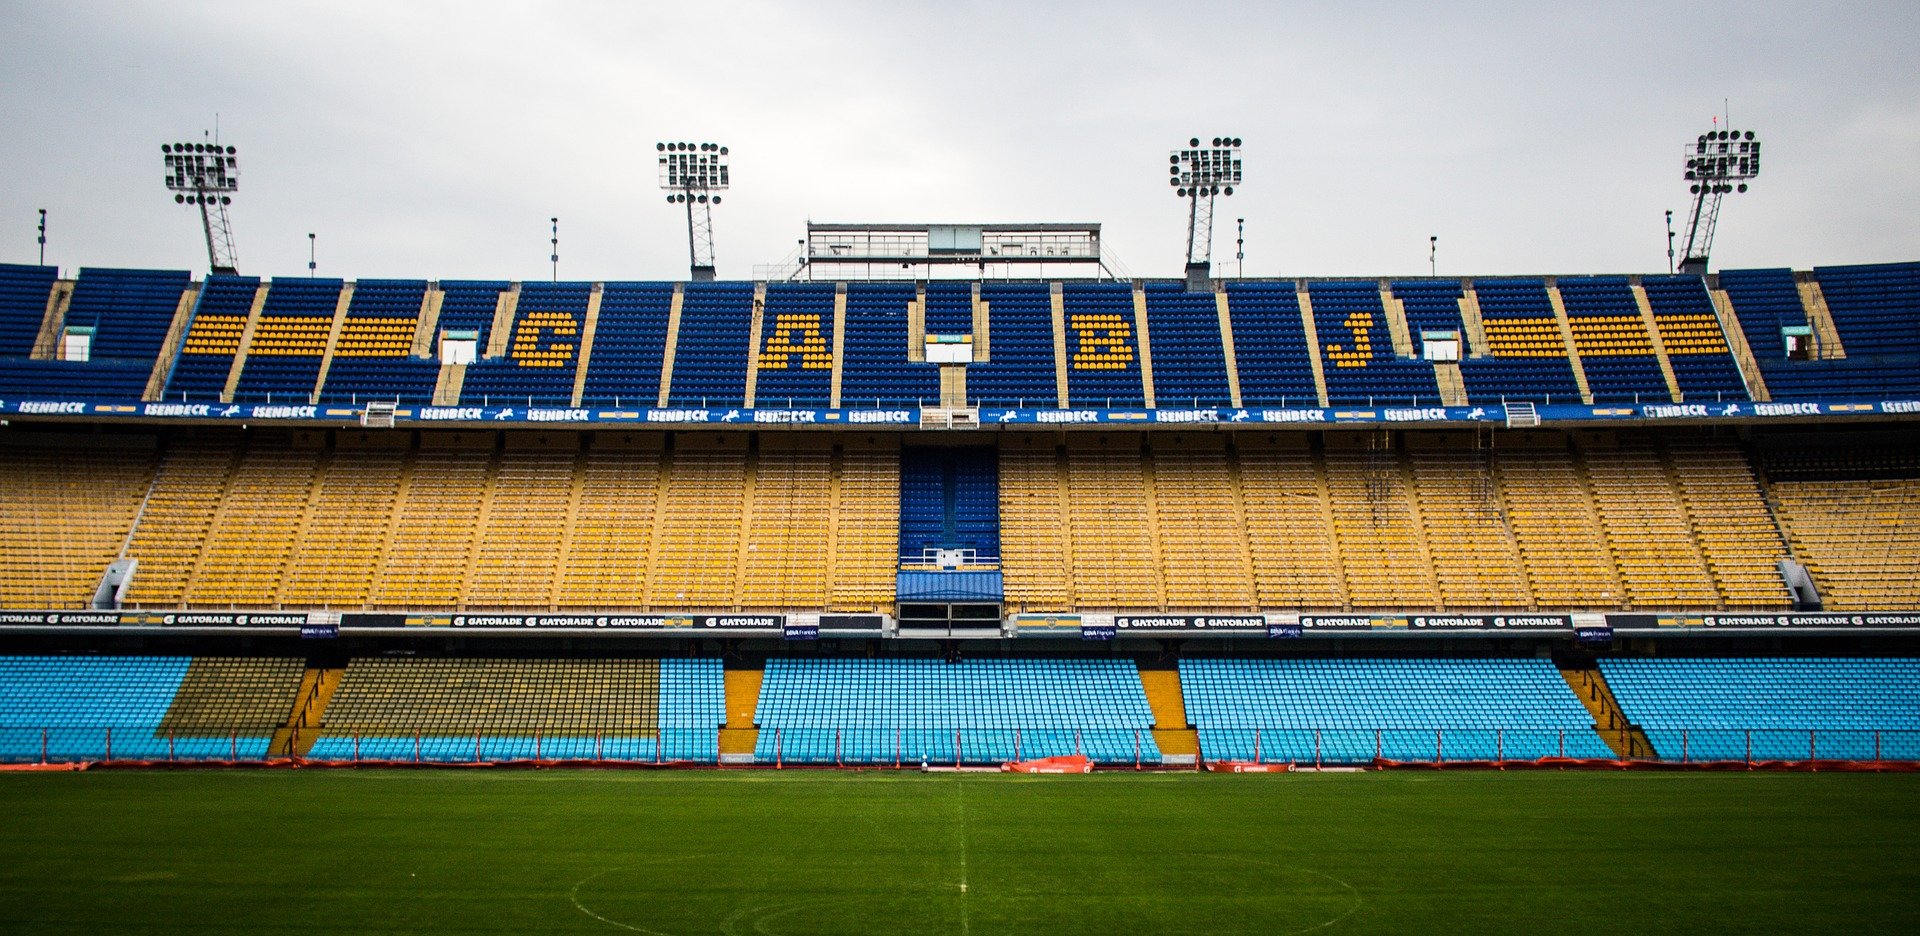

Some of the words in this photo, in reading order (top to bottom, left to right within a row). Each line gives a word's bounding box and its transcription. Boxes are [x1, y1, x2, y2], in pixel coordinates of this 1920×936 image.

[512, 312, 577, 367] C
[757, 314, 833, 368] A
[1071, 314, 1133, 369] B
[1327, 312, 1373, 367] J
[18, 402, 86, 414] ISENBECK
[144, 404, 210, 416] ISENBECK
[252, 406, 317, 418] ISENBECK
[1754, 403, 1821, 416] ISENBECK
[420, 408, 482, 420] ISENBECK
[527, 408, 589, 421] ISENBECK
[647, 410, 709, 422] ISENBECK
[848, 411, 910, 423] ISENBECK
[1036, 410, 1098, 422] ISENBECK
[1155, 410, 1219, 422] ISENBECK
[1262, 410, 1325, 423] ISENBECK
[1384, 408, 1447, 422] ISENBECK
[0, 615, 44, 623] TORADE
[61, 615, 118, 623] GATORADE
[177, 615, 233, 624] GATORADE
[250, 616, 306, 624] GATORADE
[467, 617, 523, 626] GATORADE
[539, 618, 594, 626] GATORADE
[610, 618, 664, 626] GATORADE
[719, 618, 774, 626] GATORADE
[1131, 618, 1186, 627] GATORADE
[1207, 618, 1263, 627] GATORADE
[1315, 618, 1371, 627] GATORADE
[1428, 618, 1484, 627] GATORADE
[1508, 617, 1564, 626] GATORADE
[1718, 617, 1775, 626] GATORADE
[1792, 617, 1849, 625] GATORADE
